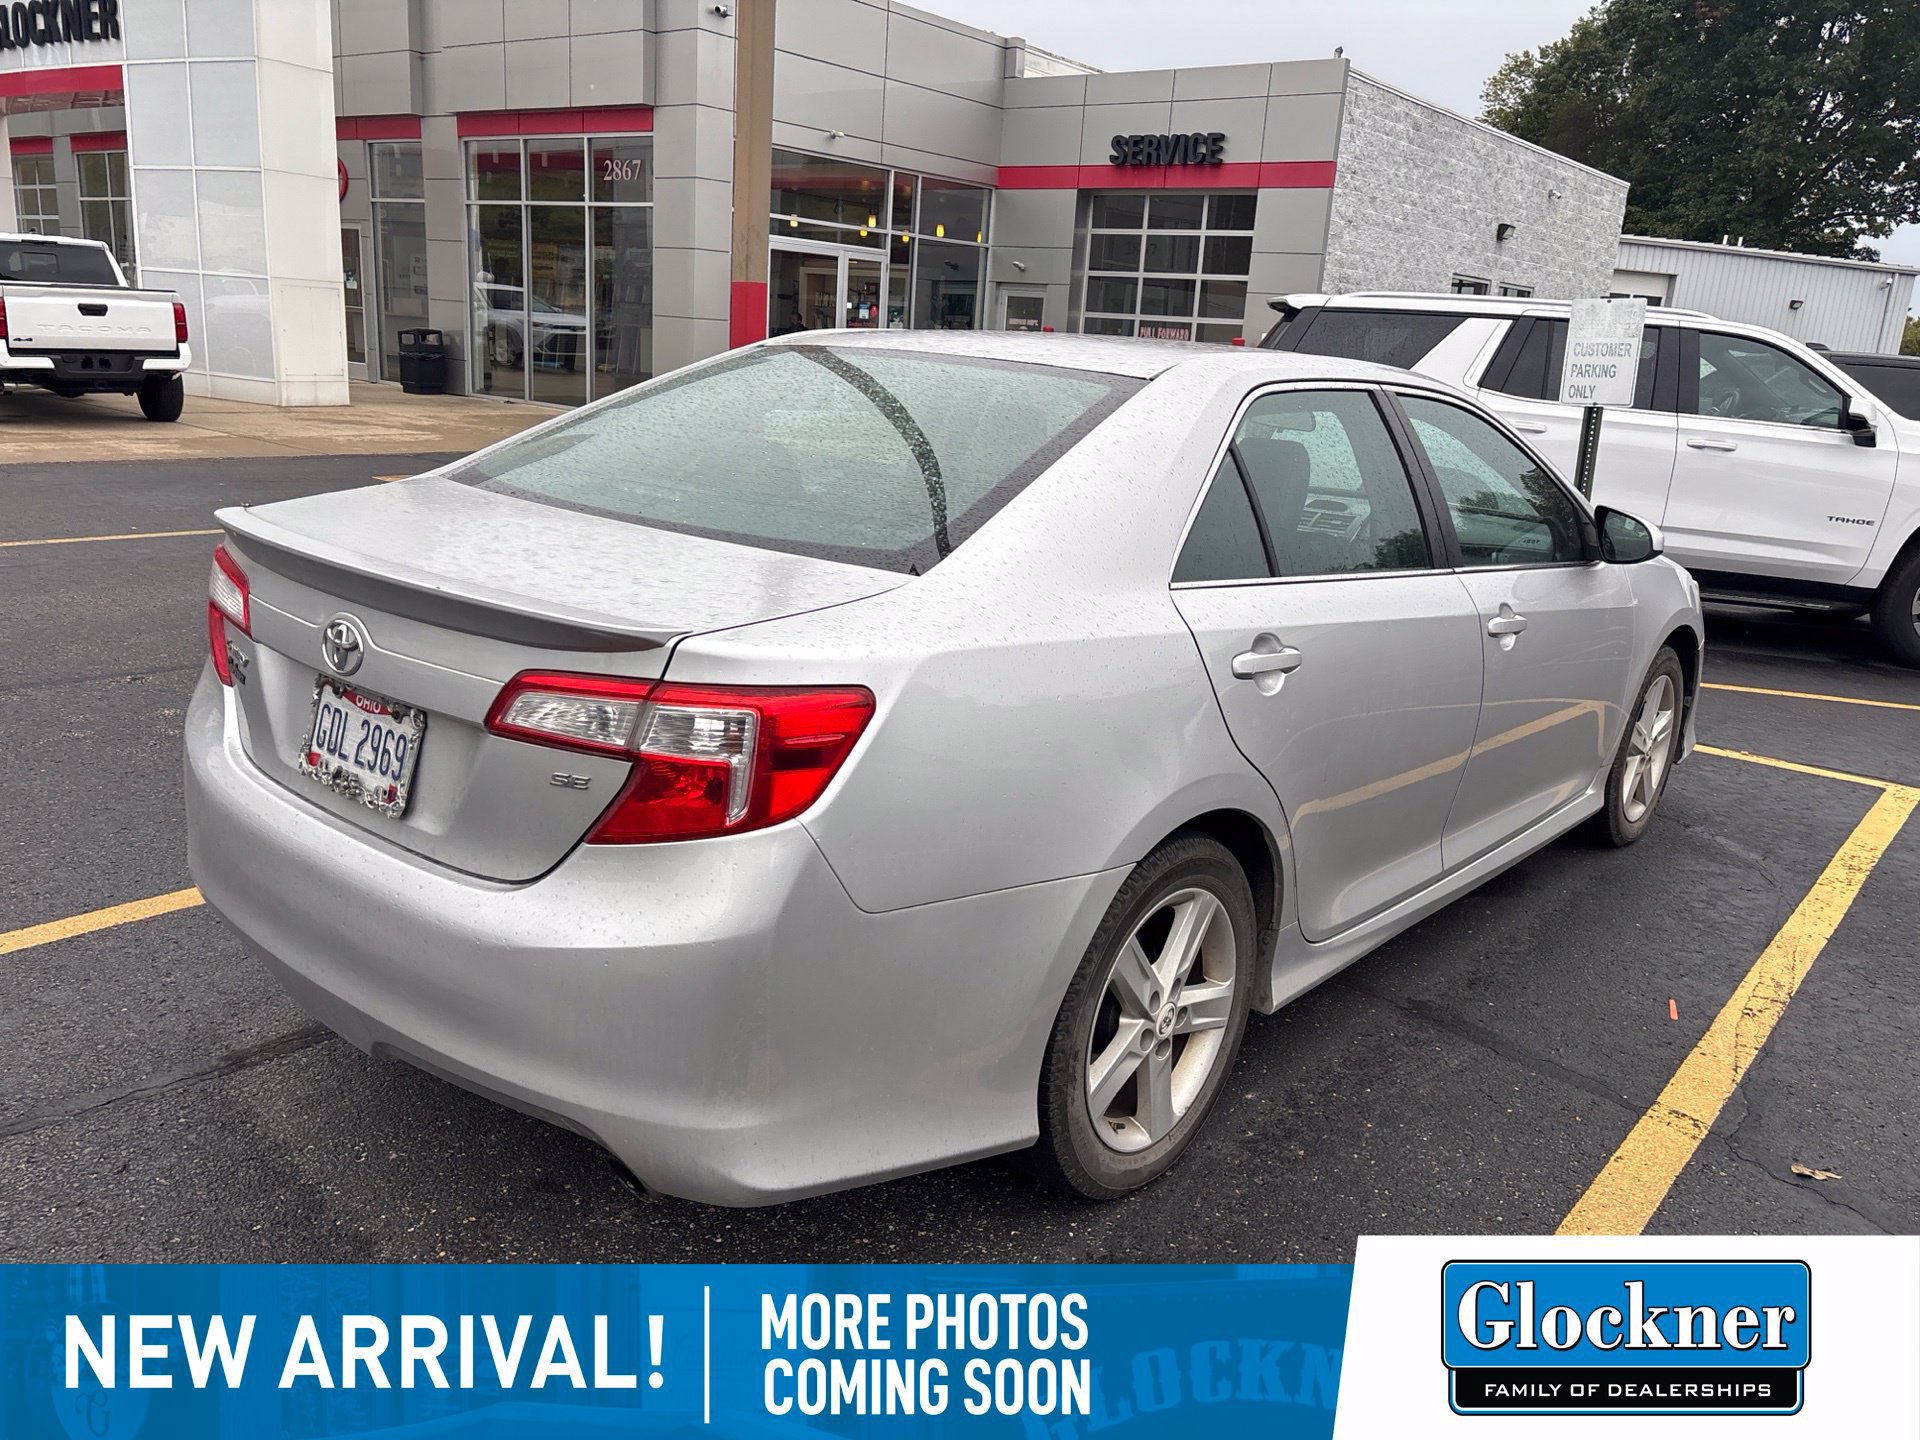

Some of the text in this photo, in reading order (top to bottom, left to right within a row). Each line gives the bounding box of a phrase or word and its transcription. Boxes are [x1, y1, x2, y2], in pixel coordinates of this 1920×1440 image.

[0, 0, 120, 50] LOCKNER
[1109, 132, 1226, 166] SERVICE
[603, 159, 642, 181] 2867
[37, 323, 153, 336] TACOMA
[1157, 327, 1190, 341] FORWARD
[1573, 342, 1632, 358] CUSTOMER
[1570, 363, 1617, 379] PARKING
[1568, 384, 1596, 400] ONLY
[1826, 515, 1876, 527] TAHOE
[355, 695, 382, 714] OHIO
[354, 719, 408, 781] 2969
[549, 771, 592, 790] SE
